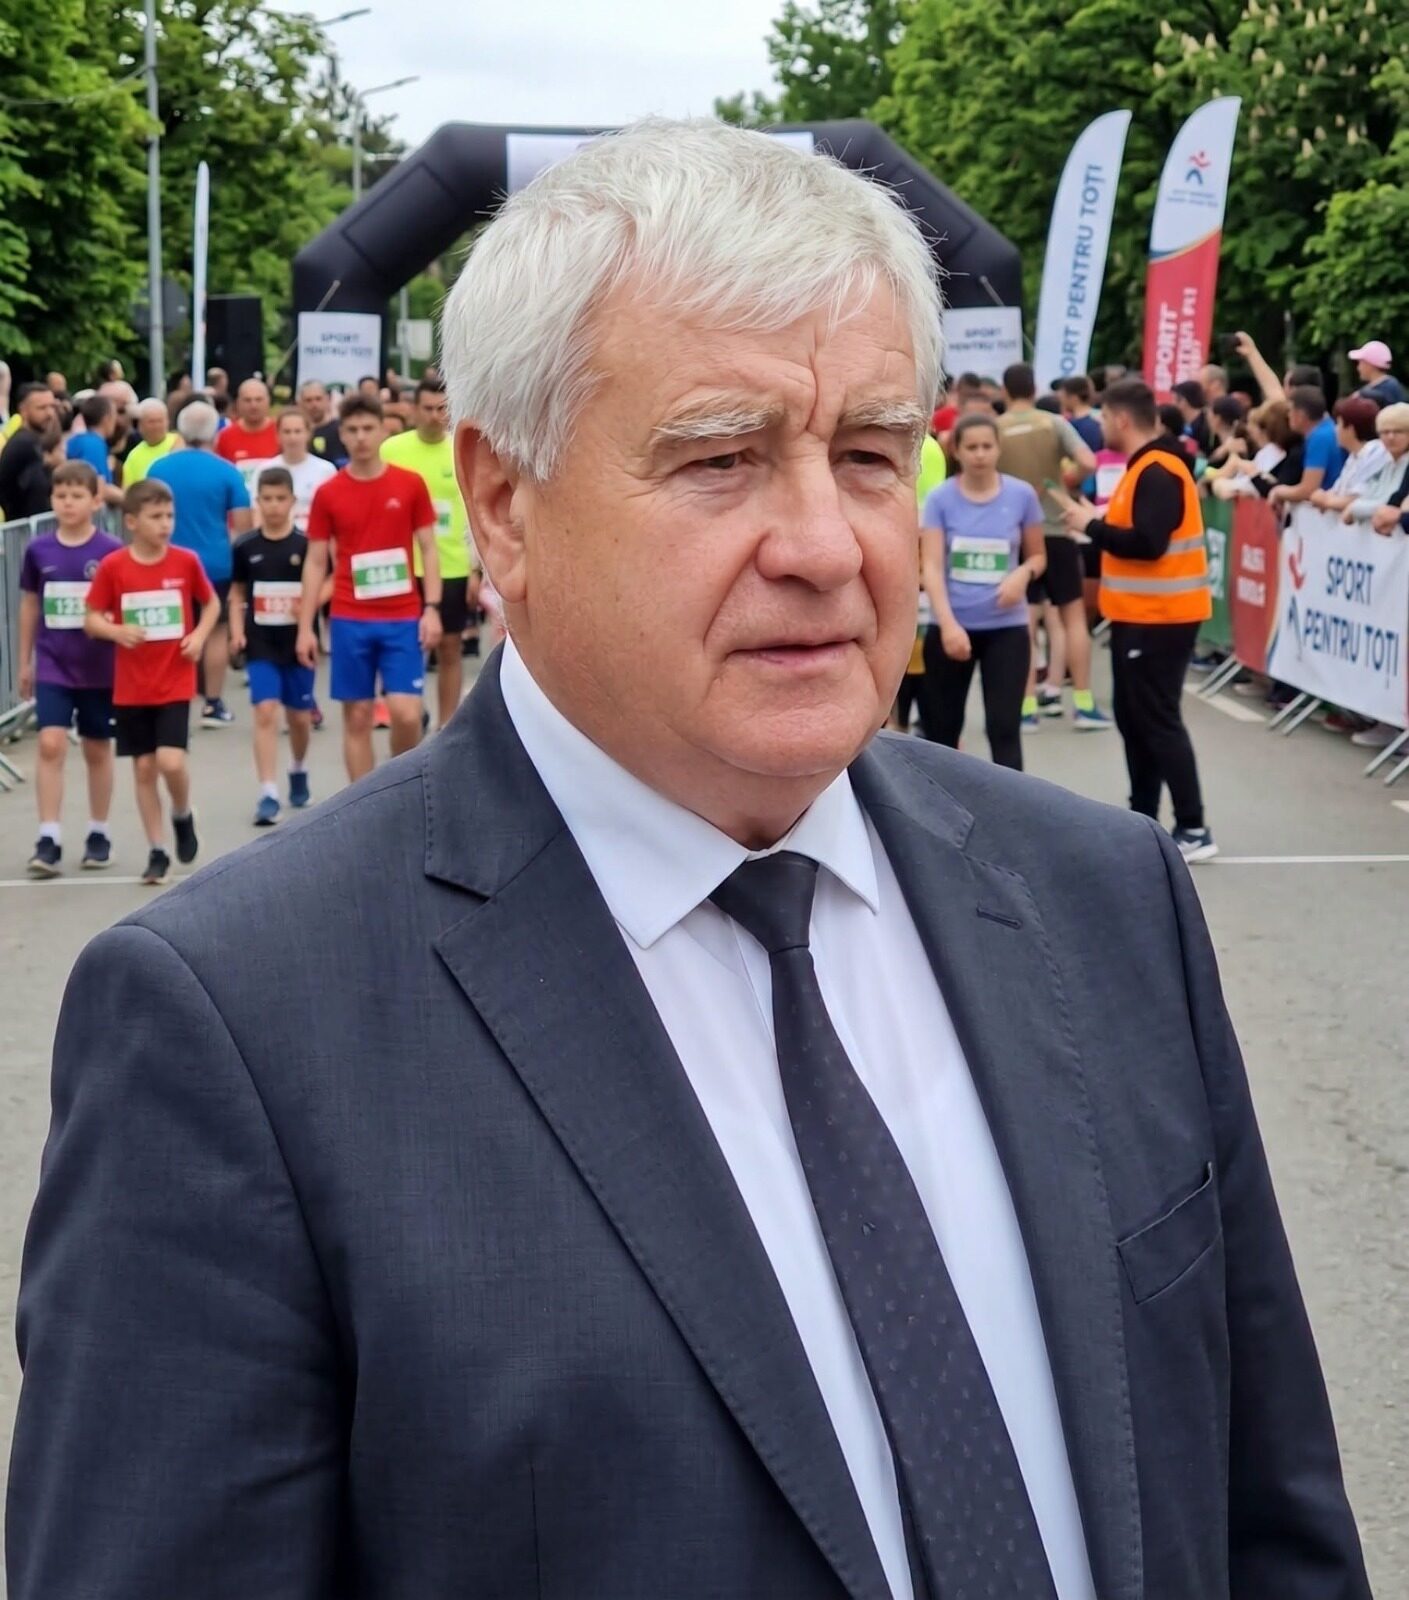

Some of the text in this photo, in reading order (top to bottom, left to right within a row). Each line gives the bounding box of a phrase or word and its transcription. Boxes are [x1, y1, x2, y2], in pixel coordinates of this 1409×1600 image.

[1066, 225, 1094, 319] PENTRU
[1059, 326, 1081, 377] ORT
[1326, 556, 1375, 607] SPORT
[1303, 608, 1361, 662] PENTRU
